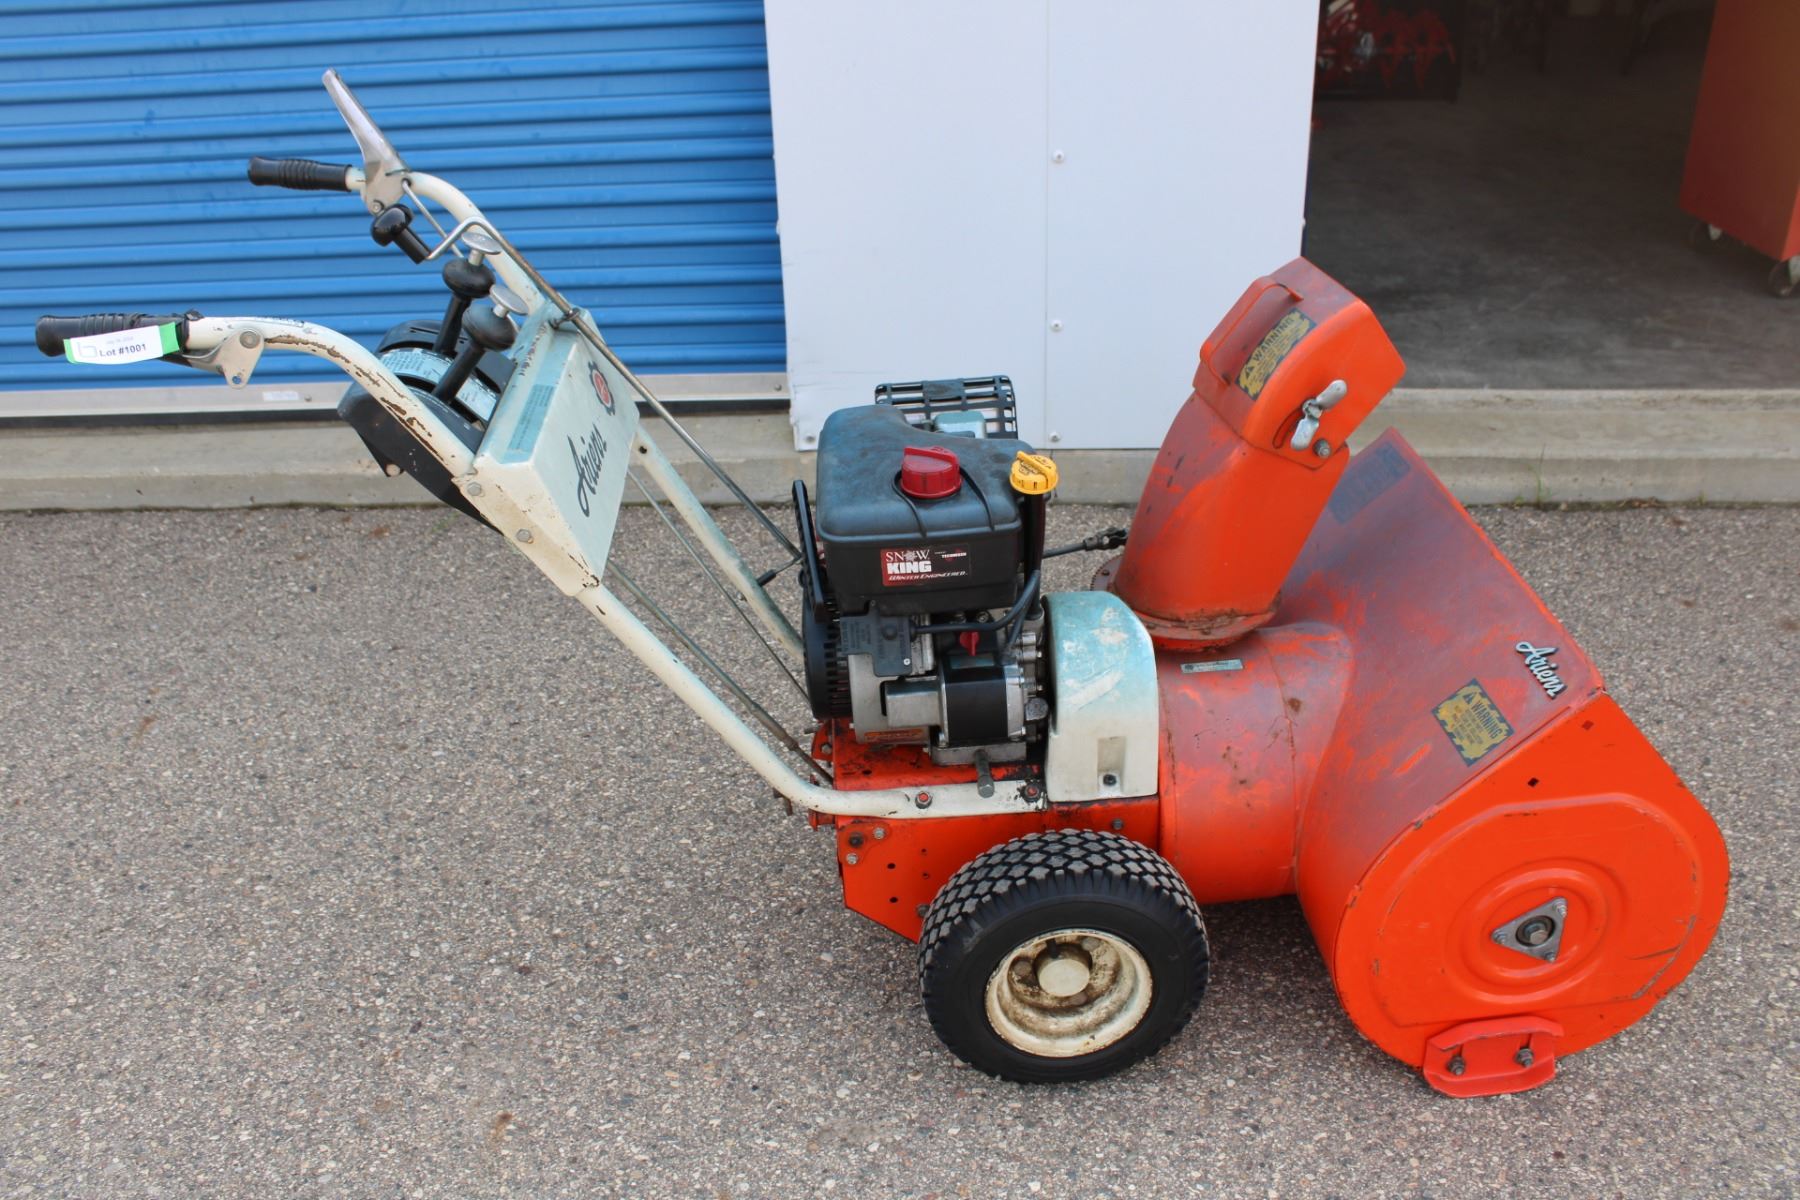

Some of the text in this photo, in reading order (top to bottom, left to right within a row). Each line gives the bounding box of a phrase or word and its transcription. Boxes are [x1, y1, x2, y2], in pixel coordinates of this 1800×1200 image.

[99, 343, 147, 357] Lot #1001
[1252, 316, 1295, 361] WARNING
[566, 423, 608, 518] Ariens
[886, 560, 932, 575] KING
[1515, 641, 1567, 698] Ariens
[1470, 699, 1503, 739] WARNING
